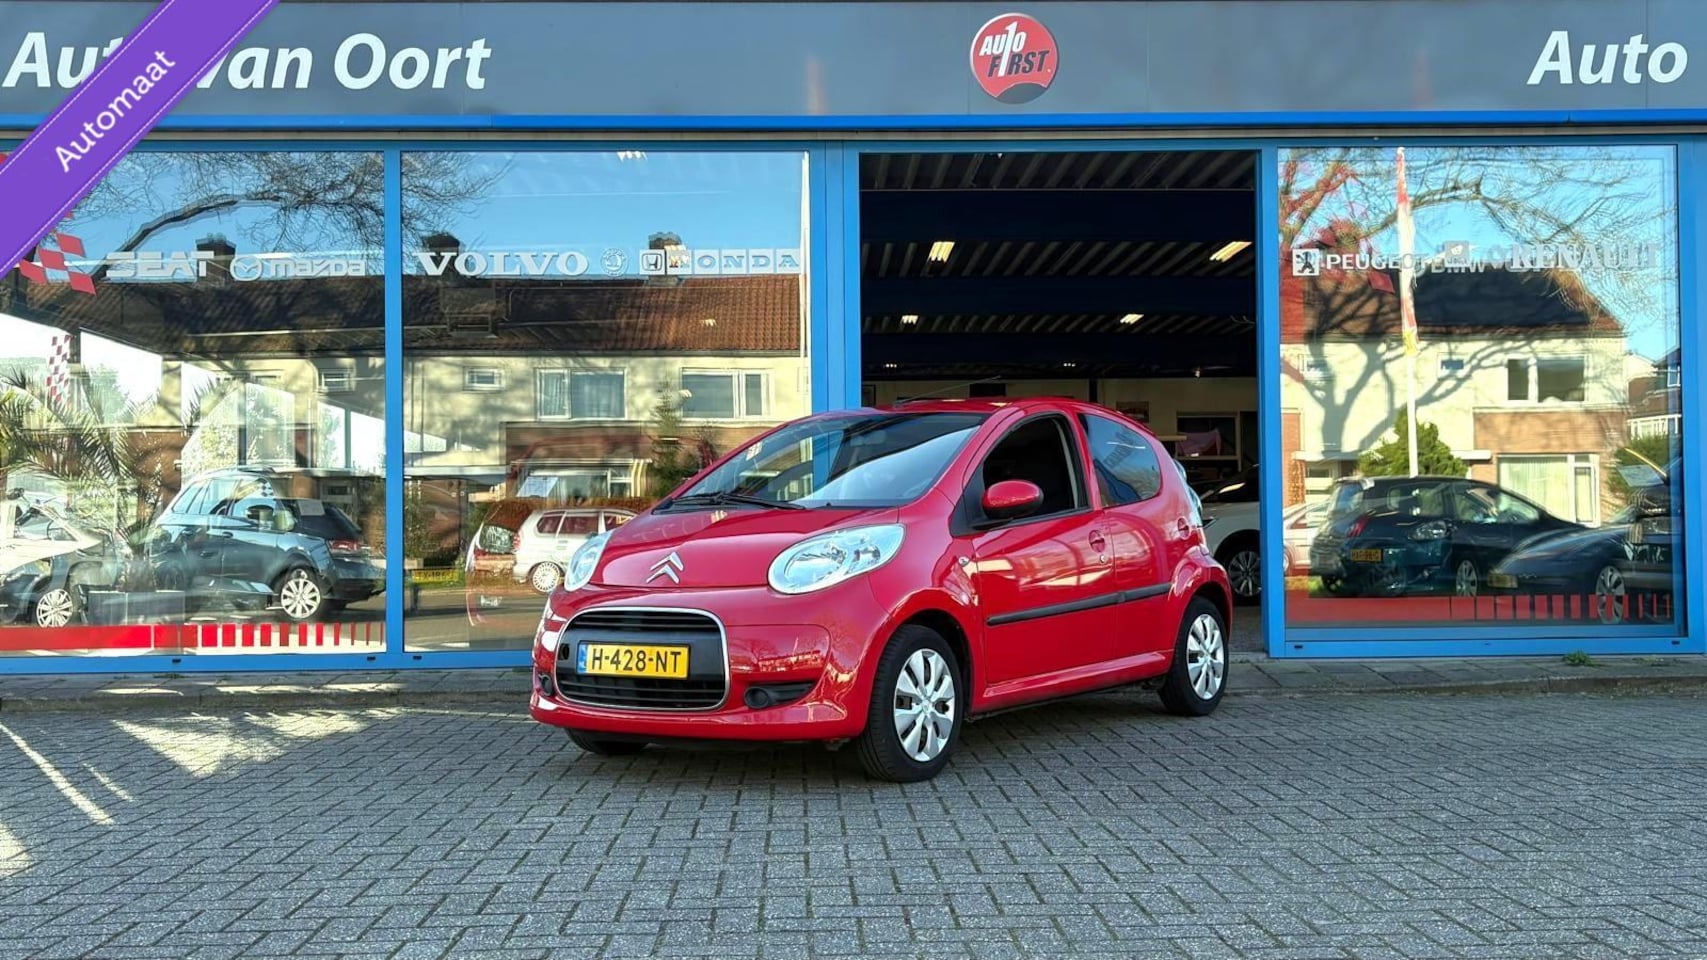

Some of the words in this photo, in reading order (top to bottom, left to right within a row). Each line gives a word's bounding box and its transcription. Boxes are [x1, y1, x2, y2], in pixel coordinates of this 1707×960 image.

[2, 32, 124, 88] Au
[334, 33, 492, 89] Oort
[1526, 31, 1688, 85] Auto
[106, 251, 214, 277] SEAT
[413, 251, 590, 276] VOLVO
[592, 647, 682, 673] H-428-NT
